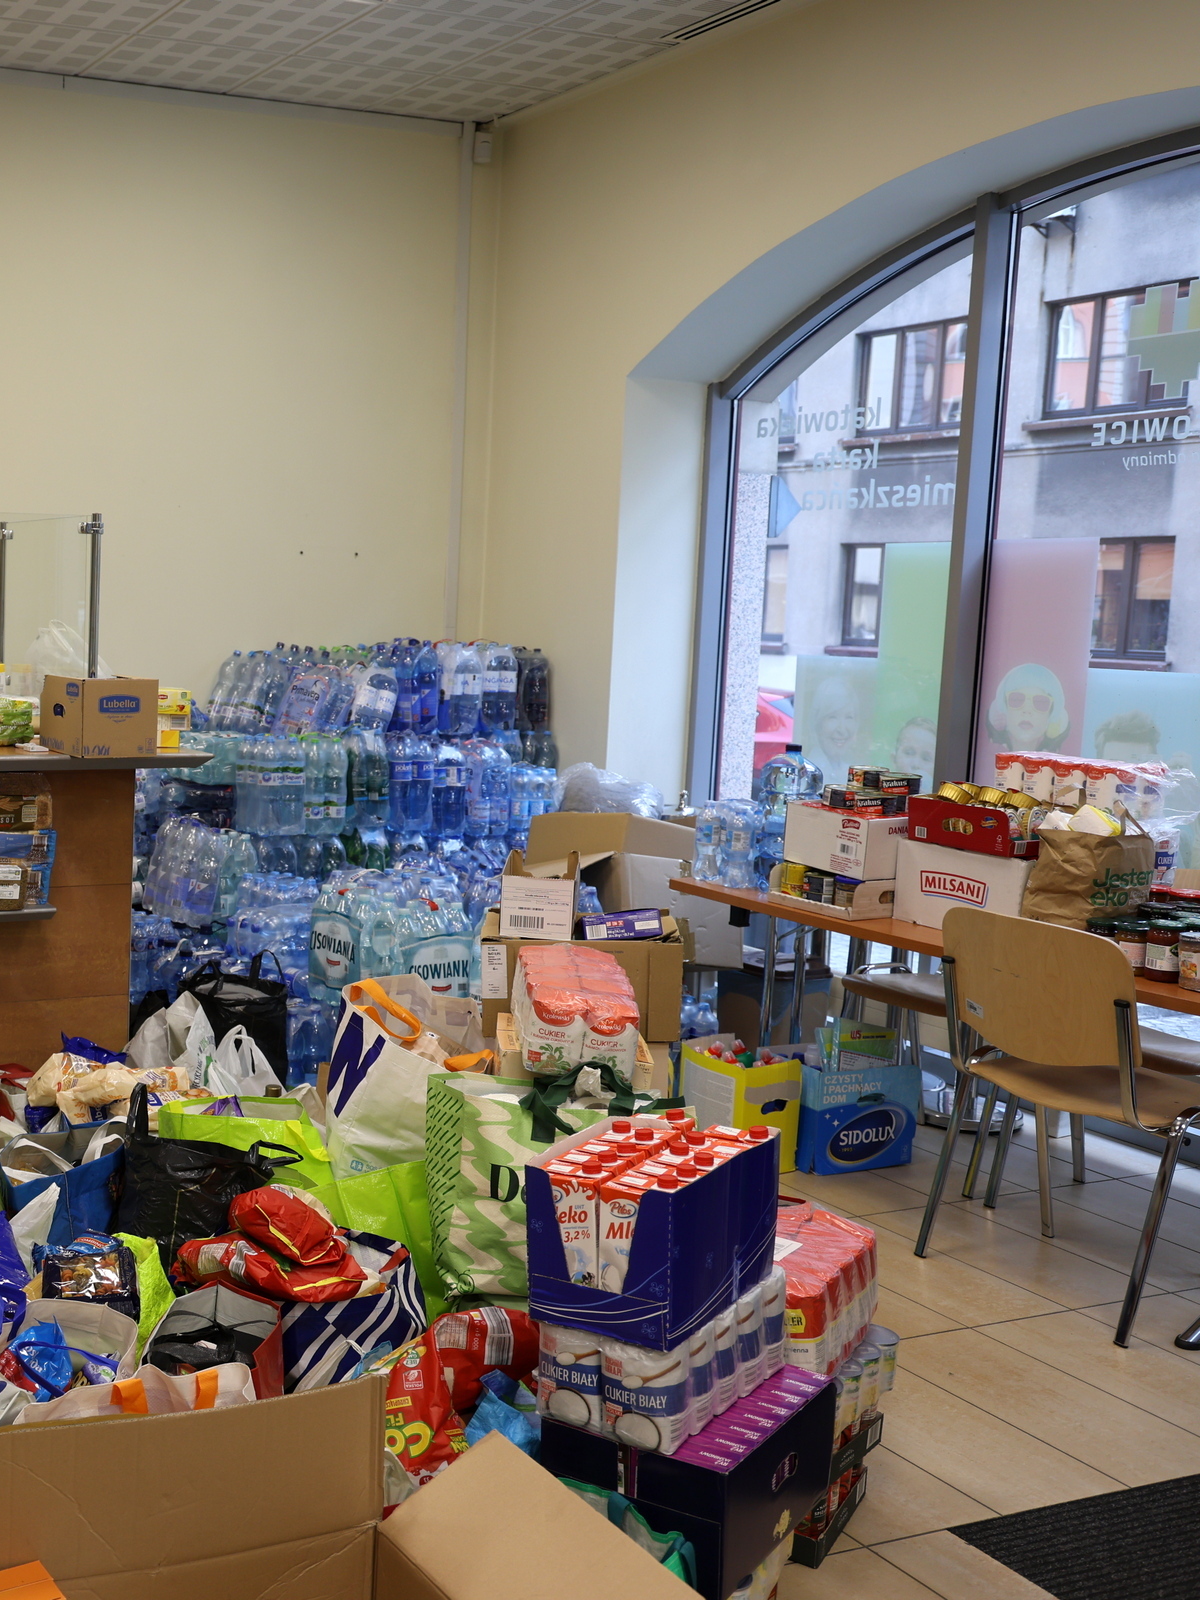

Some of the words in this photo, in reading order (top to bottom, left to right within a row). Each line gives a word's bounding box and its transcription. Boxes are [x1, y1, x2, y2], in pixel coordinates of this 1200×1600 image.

[290, 684, 320, 701] Primavera
[103, 697, 137, 708] Lubella
[888, 827, 909, 835] DANIA
[923, 874, 984, 902] MILSANI
[1089, 892, 1129, 907] eko
[310, 930, 356, 965] CISOWIANKA
[538, 1027, 566, 1038] CUKIER
[824, 1073, 864, 1084] CZYSTY
[828, 1081, 882, 1094] PACHNĄCY
[823, 1094, 847, 1104] DOM
[839, 1126, 896, 1146] SIDOLUX
[610, 1201, 632, 1215] Pilos
[541, 1360, 568, 1381] CUKIER
[571, 1370, 599, 1387] BIAŁY
[604, 1385, 636, 1406] CUKIER
[639, 1395, 667, 1409] BIAŁY
[385, 1420, 435, 1458] CO
